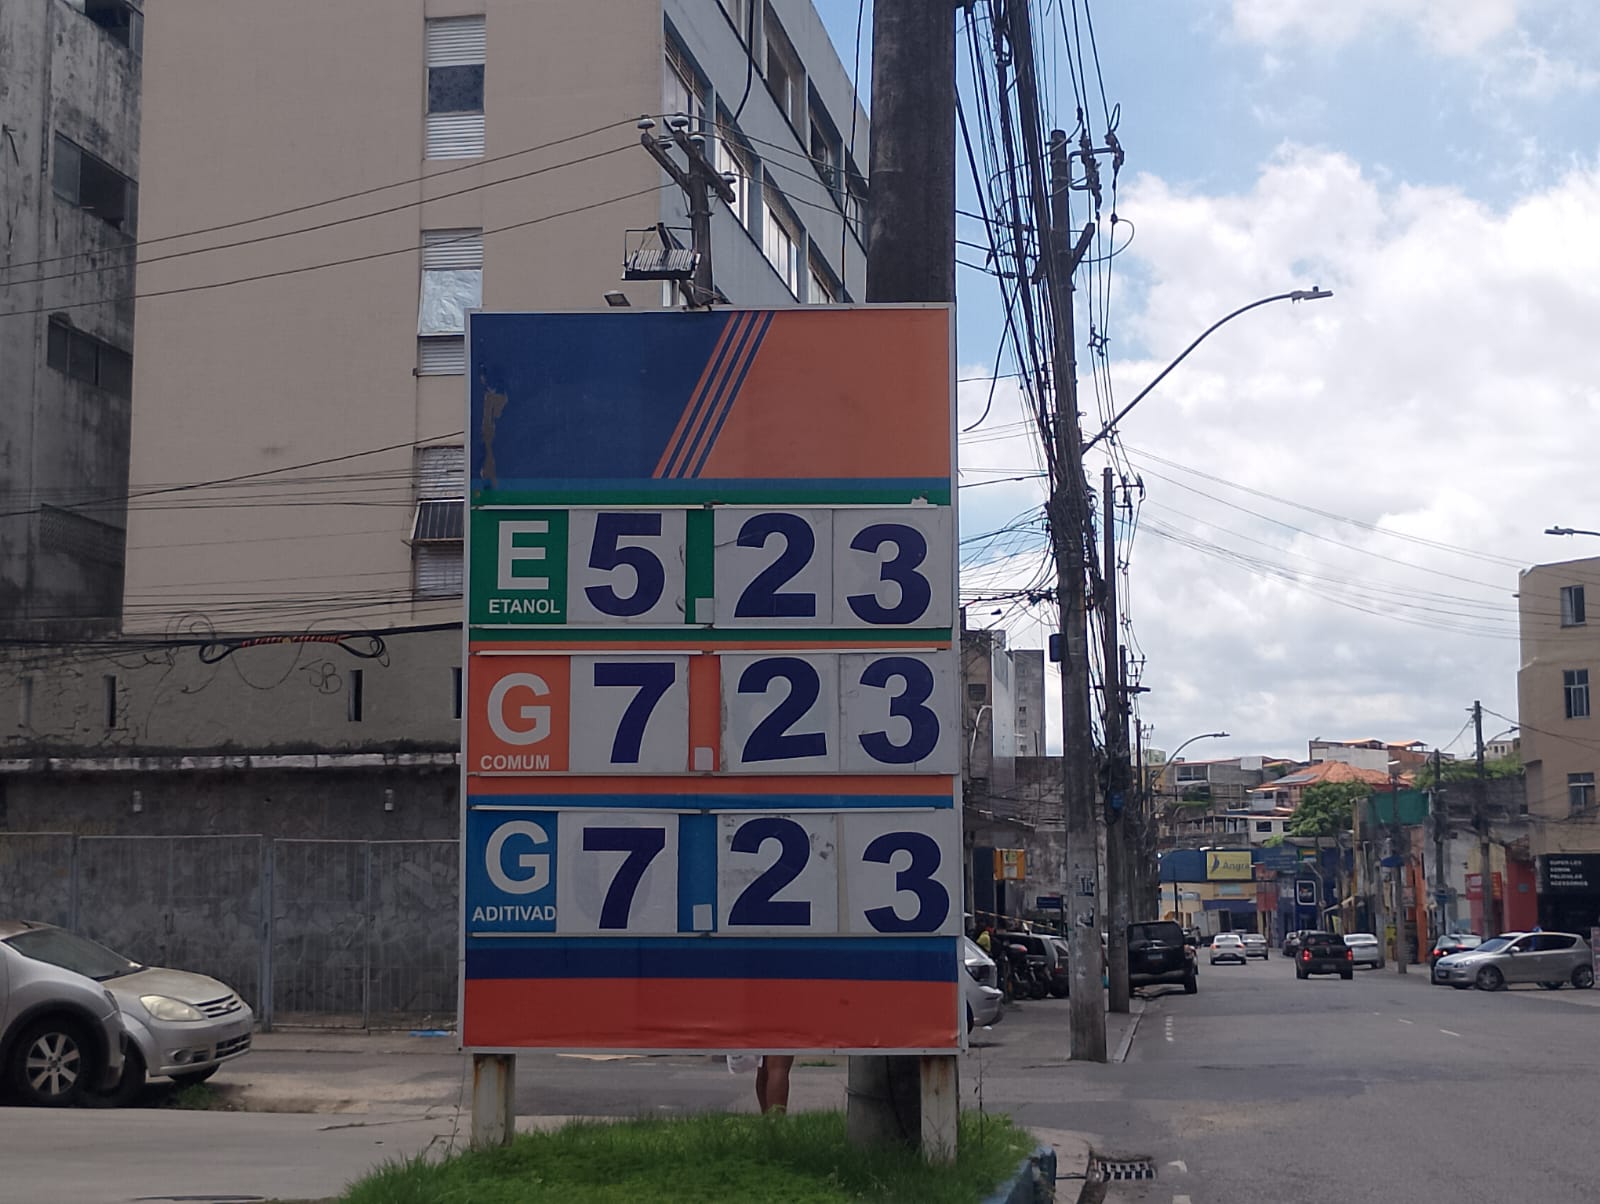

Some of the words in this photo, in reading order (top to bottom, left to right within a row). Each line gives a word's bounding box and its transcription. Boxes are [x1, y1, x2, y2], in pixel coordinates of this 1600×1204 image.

[488, 600, 561, 614] ETANOL
[497, 521, 549, 590] E
[584, 512, 932, 625] 5.23
[480, 755, 550, 770] COMUM
[487, 672, 552, 745] G
[594, 656, 940, 771] 7.23
[485, 820, 551, 895] G
[583, 817, 950, 933] 7.23
